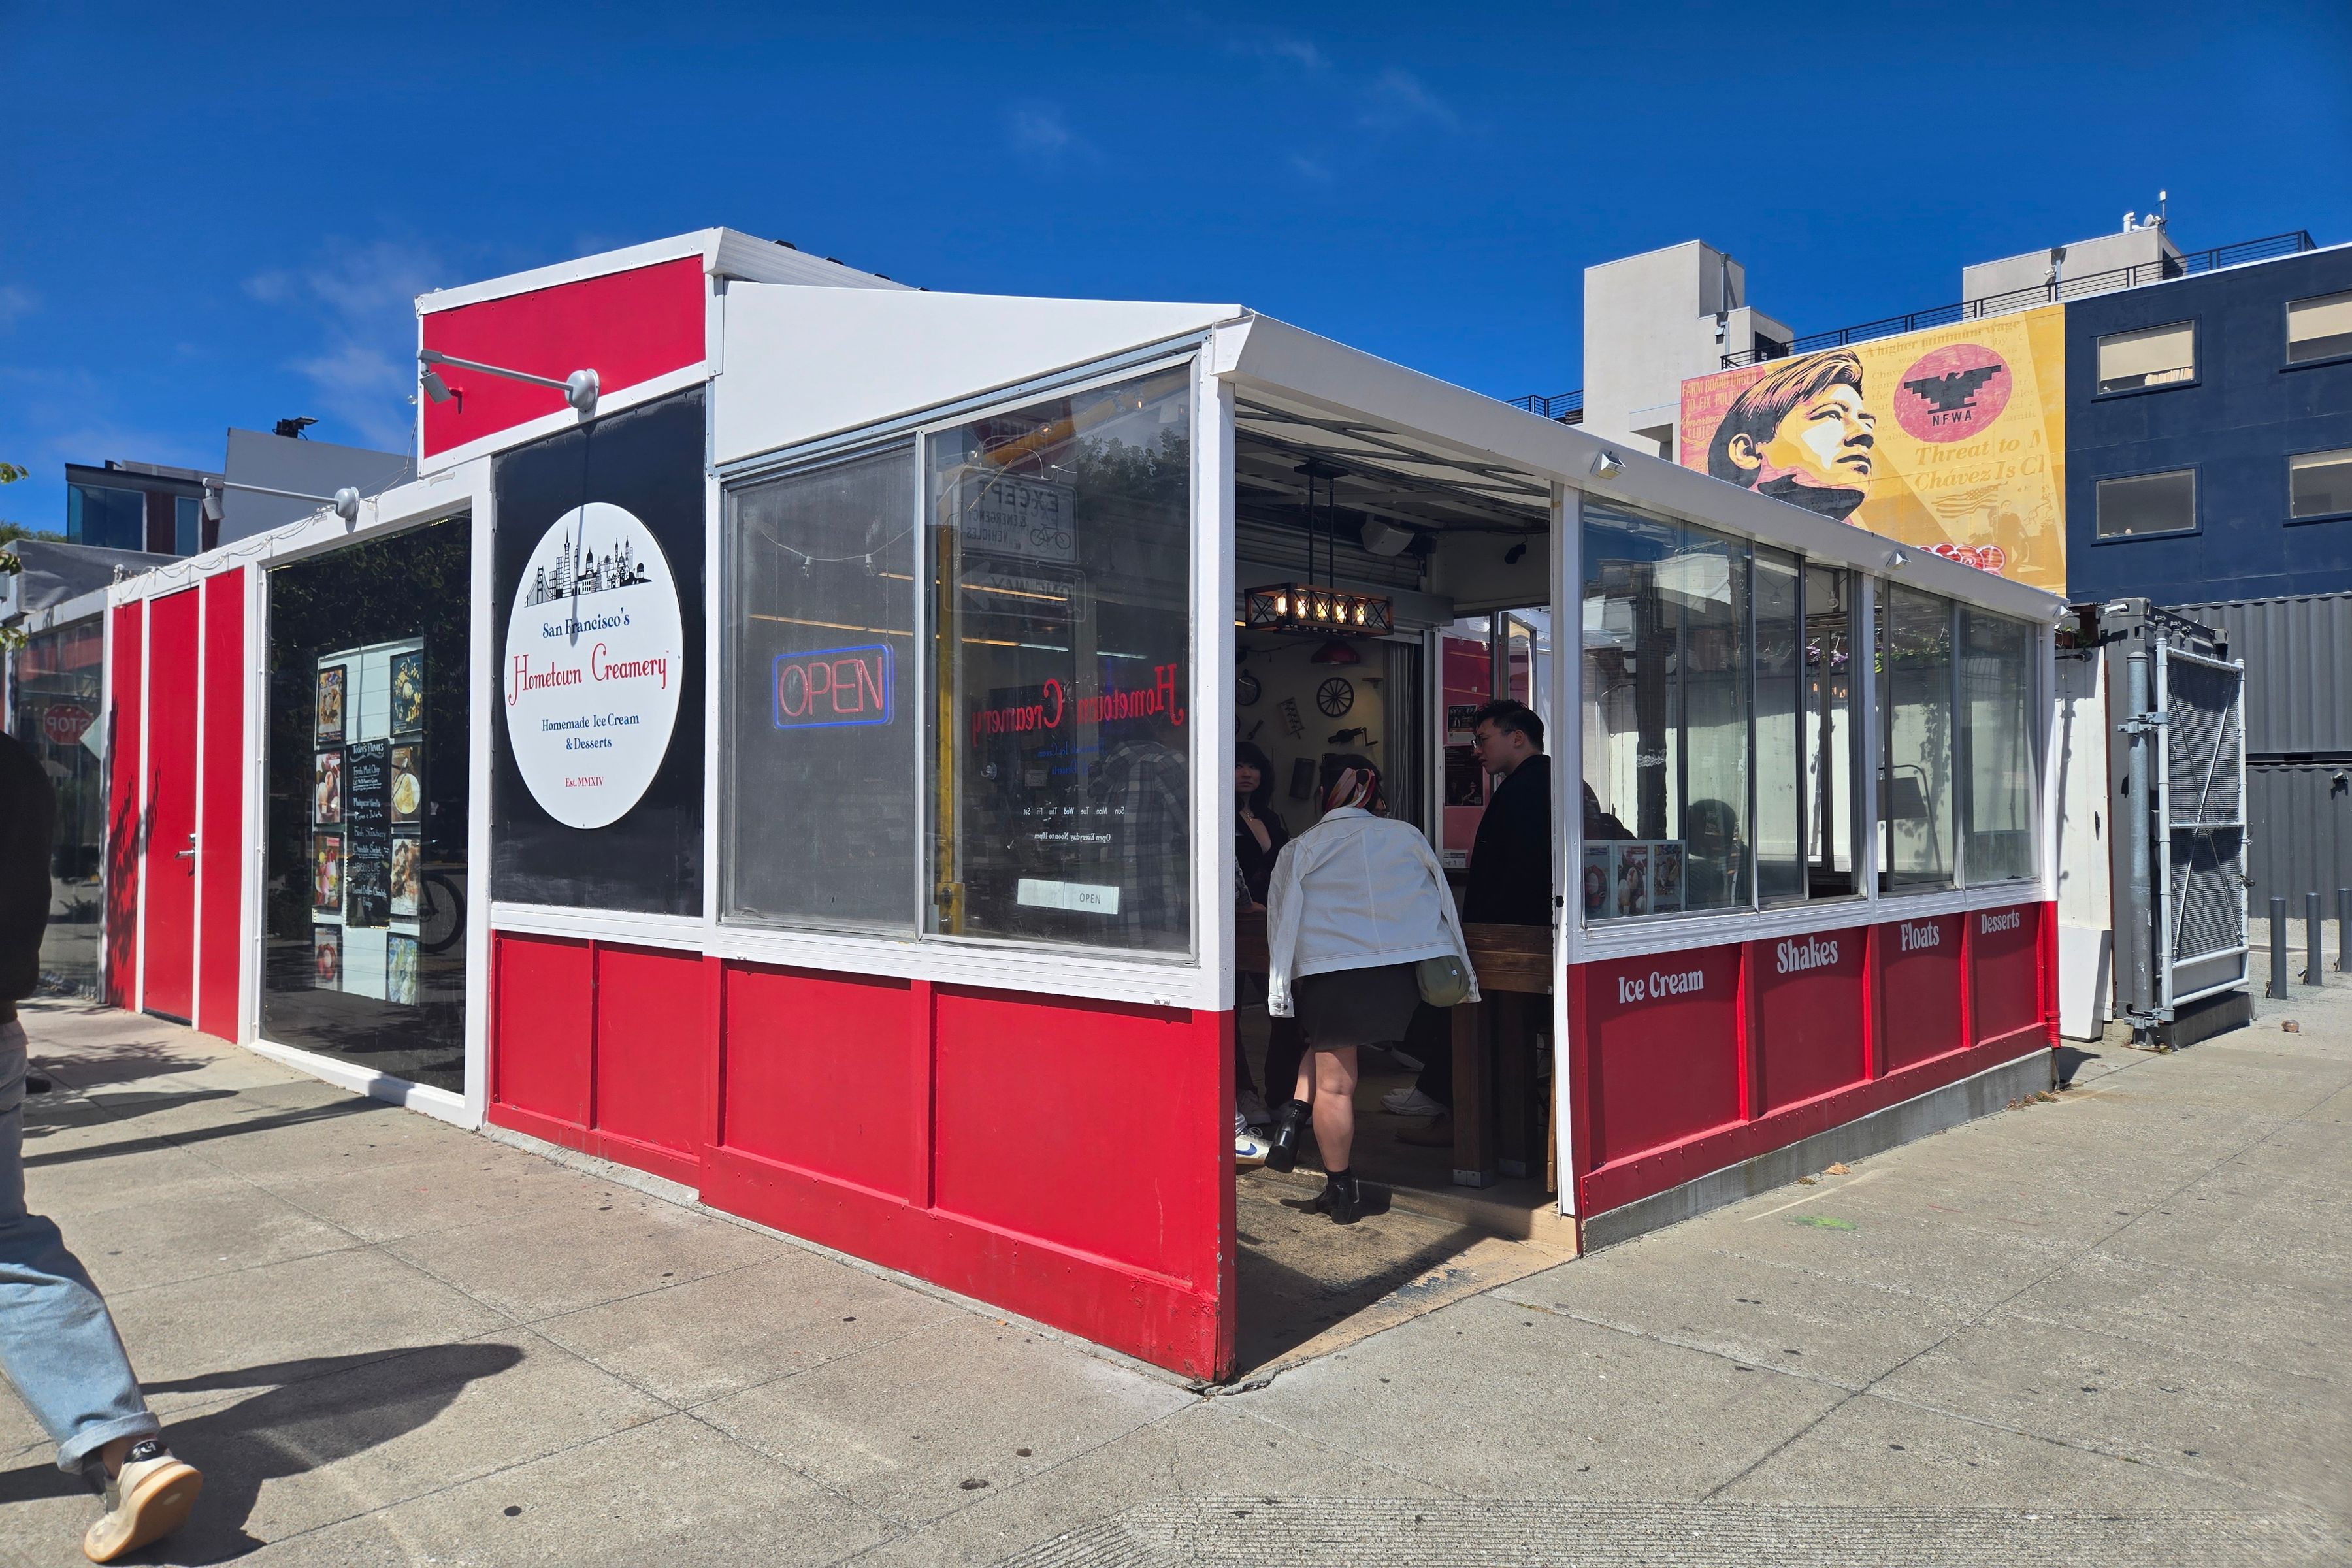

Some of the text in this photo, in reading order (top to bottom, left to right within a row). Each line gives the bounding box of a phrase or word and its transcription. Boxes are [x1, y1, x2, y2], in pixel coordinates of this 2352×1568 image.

[1878, 340, 1918, 356] higher
[1682, 370, 1757, 398] FARM BOARD URGED
[1686, 399, 1695, 412] TO
[1700, 395, 1711, 410] FIX
[1932, 410, 1972, 427] NFWA
[1915, 440, 1990, 466] Threat
[1998, 437, 2021, 454] to
[1915, 468, 1993, 491] Chávez
[1995, 460, 2016, 480] Is
[542, 607, 630, 638] San Francisco's
[508, 643, 666, 706] Hometown Creamery
[779, 657, 883, 717] OPEN
[542, 713, 640, 732] Homemade Ice Cream
[566, 736, 612, 751] & Desserts
[565, 776, 604, 787] Est. MMXIV
[1079, 892, 1101, 904] OPEN
[1981, 909, 2021, 934] Desserts
[1901, 921, 1940, 951] Floats
[1776, 936, 1838, 973] Shakes
[1619, 970, 1704, 1004] Ice Cream
